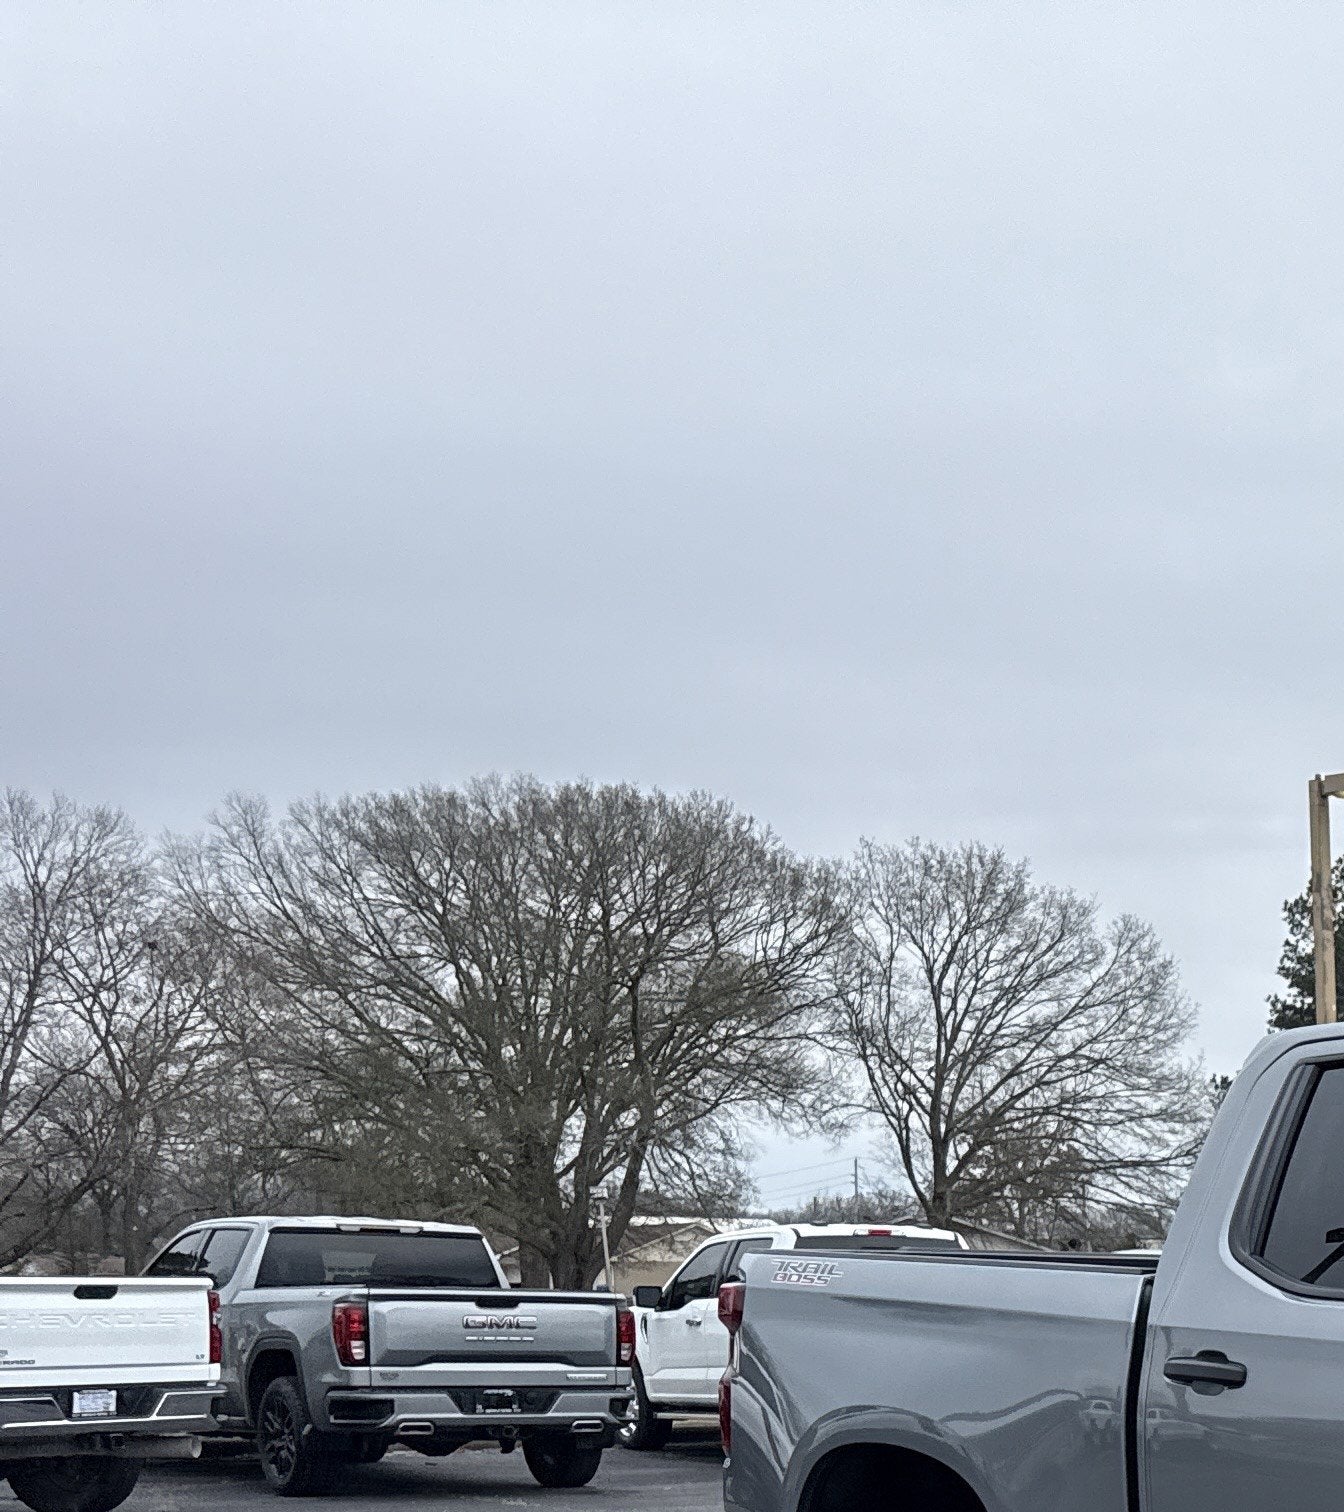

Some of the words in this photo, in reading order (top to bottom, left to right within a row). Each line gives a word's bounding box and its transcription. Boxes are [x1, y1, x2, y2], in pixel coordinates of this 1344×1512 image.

[772, 1259, 844, 1276] TRAIL
[772, 1272, 830, 1286] BOSS
[463, 1315, 537, 1330] GMC
